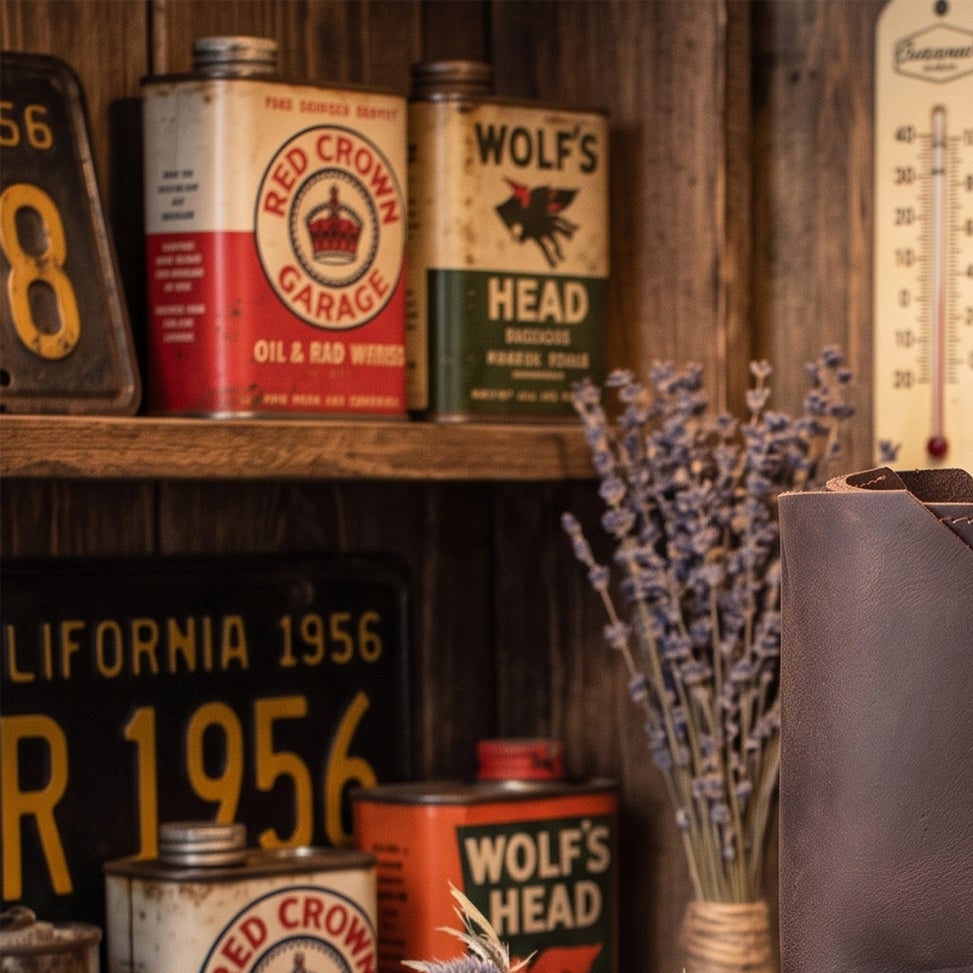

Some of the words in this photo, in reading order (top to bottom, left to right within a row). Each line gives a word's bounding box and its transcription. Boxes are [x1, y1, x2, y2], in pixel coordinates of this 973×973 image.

[0, 100, 54, 149] 56
[474, 120, 598, 174] WOLF'S
[263, 147, 308, 219] RED
[315, 133, 400, 224] CROWN
[0, 183, 81, 360] 8
[277, 265, 391, 322] GARAGE
[487, 276, 590, 325] HEAD
[253, 338, 287, 364] OIL
[289, 340, 306, 364] &
[7, 614, 249, 683] LIFORNIA
[279, 611, 383, 668] 1956
[0, 713, 73, 901] R
[124, 691, 378, 864] 1956
[464, 819, 613, 886] WOLF'S
[488, 880, 603, 937] HEAD
